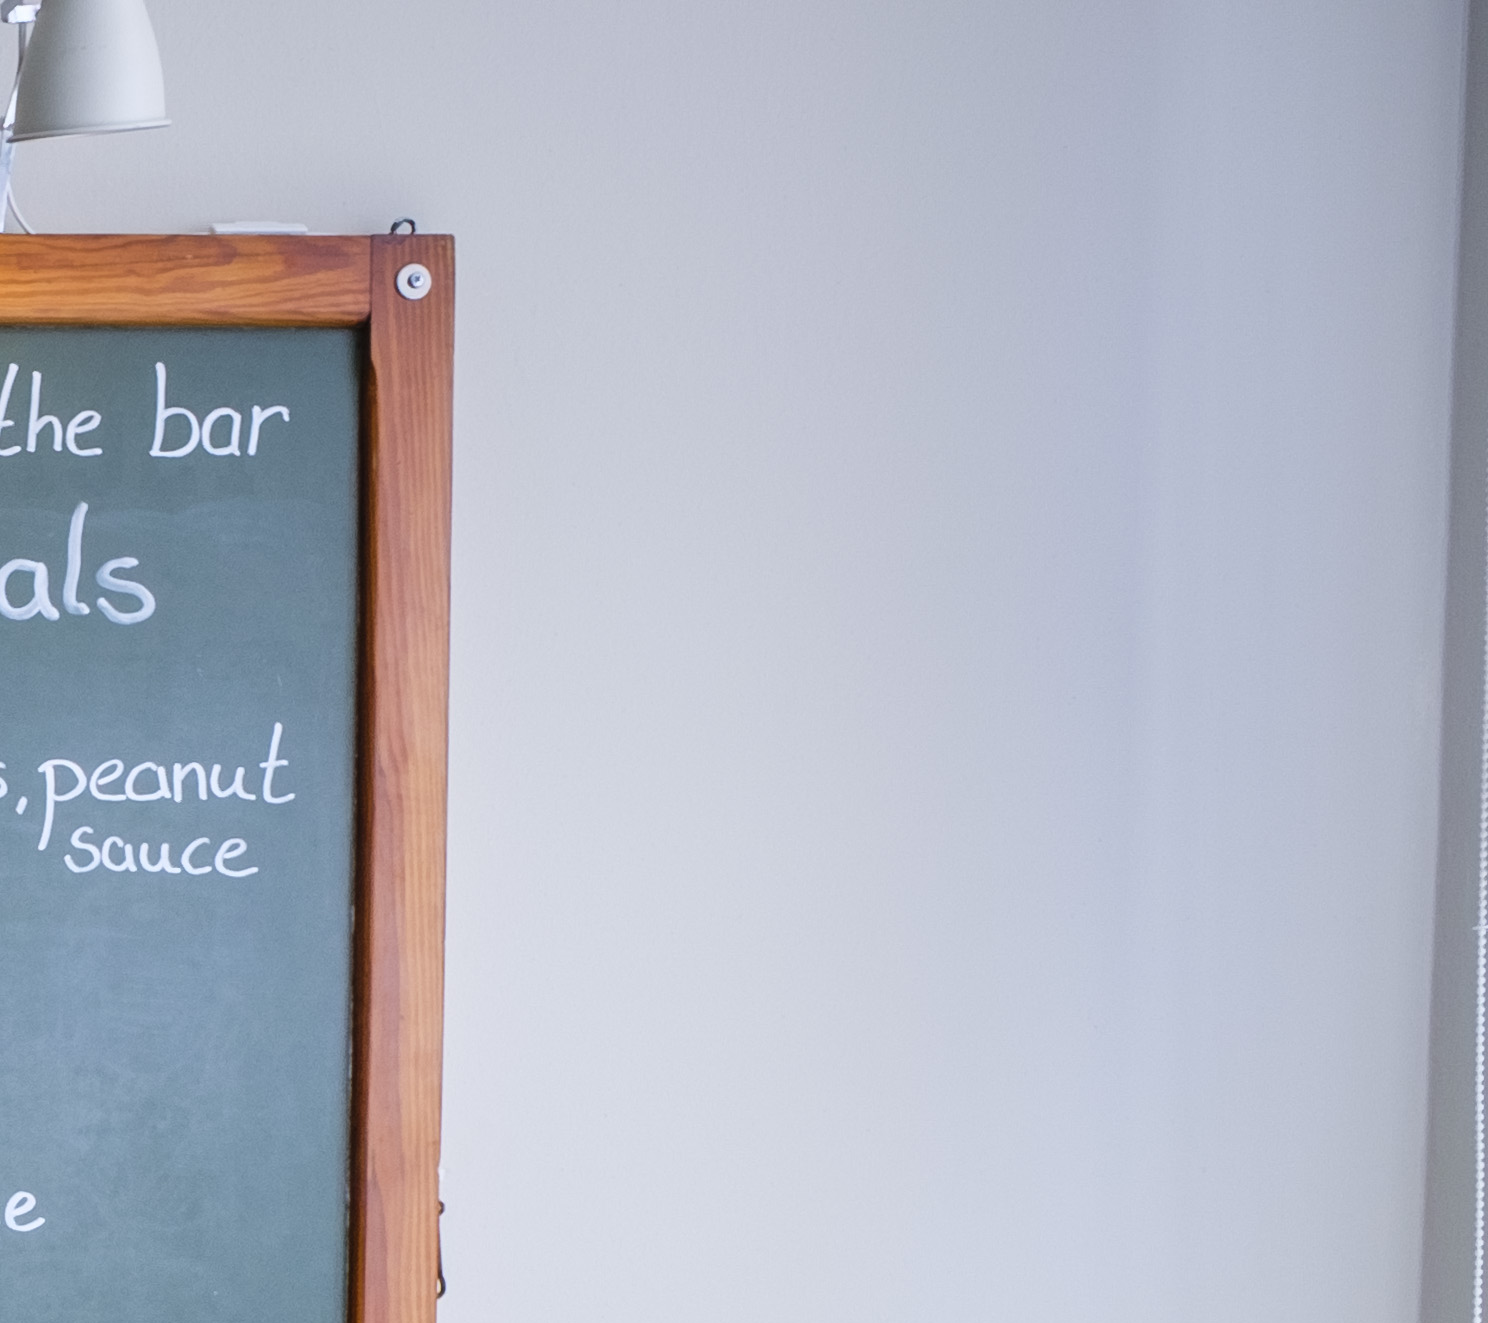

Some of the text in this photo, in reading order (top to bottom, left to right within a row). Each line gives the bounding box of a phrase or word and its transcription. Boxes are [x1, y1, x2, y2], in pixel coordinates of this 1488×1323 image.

[150, 362, 290, 458] bar
[37, 722, 297, 851] peanut
[64, 824, 260, 878] sauce
